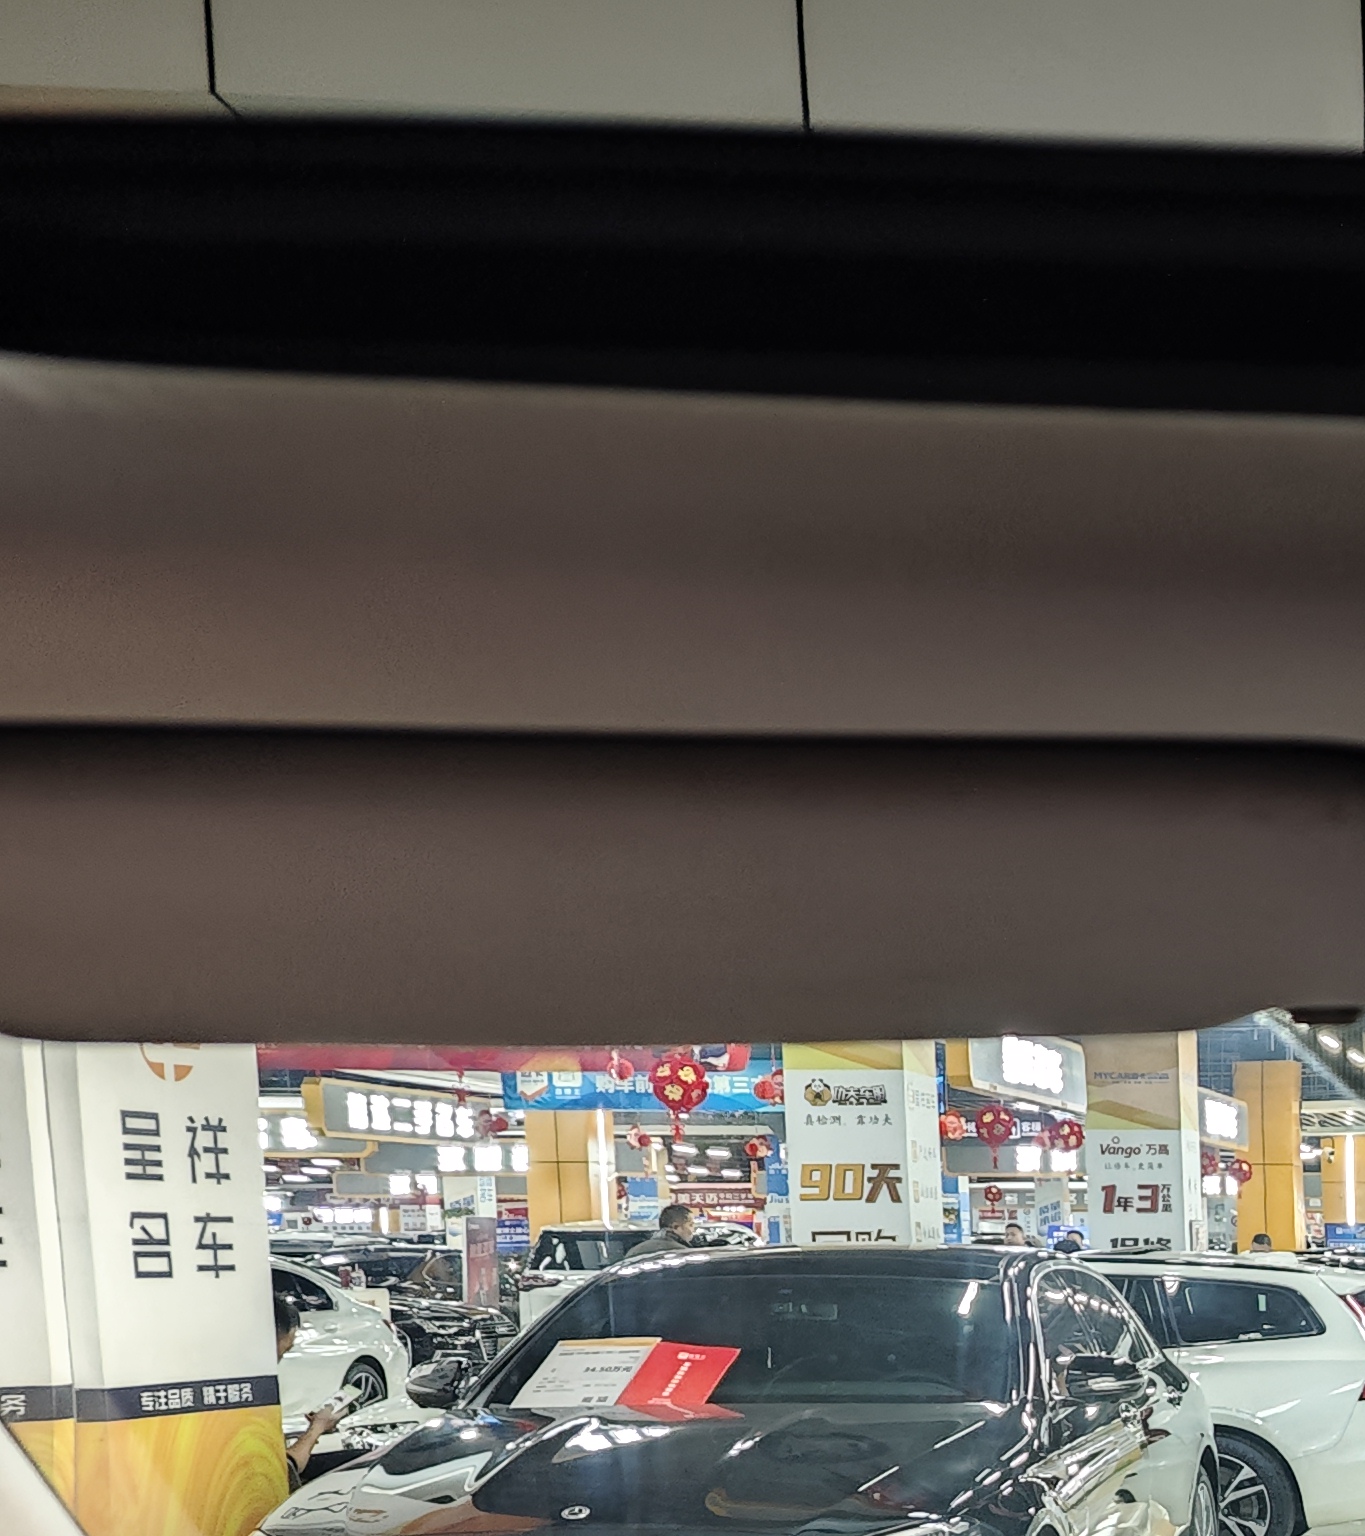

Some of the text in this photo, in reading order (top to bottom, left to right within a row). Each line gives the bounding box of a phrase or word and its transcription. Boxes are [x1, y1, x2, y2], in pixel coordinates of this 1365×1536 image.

[120, 1110, 230, 1184] 呈祥
[1099, 1143, 1141, 1158] Vango
[799, 1163, 903, 1204] 90天
[129, 1211, 236, 1279] 名车
[140, 1383, 254, 1411] 专注品质 精于服务
